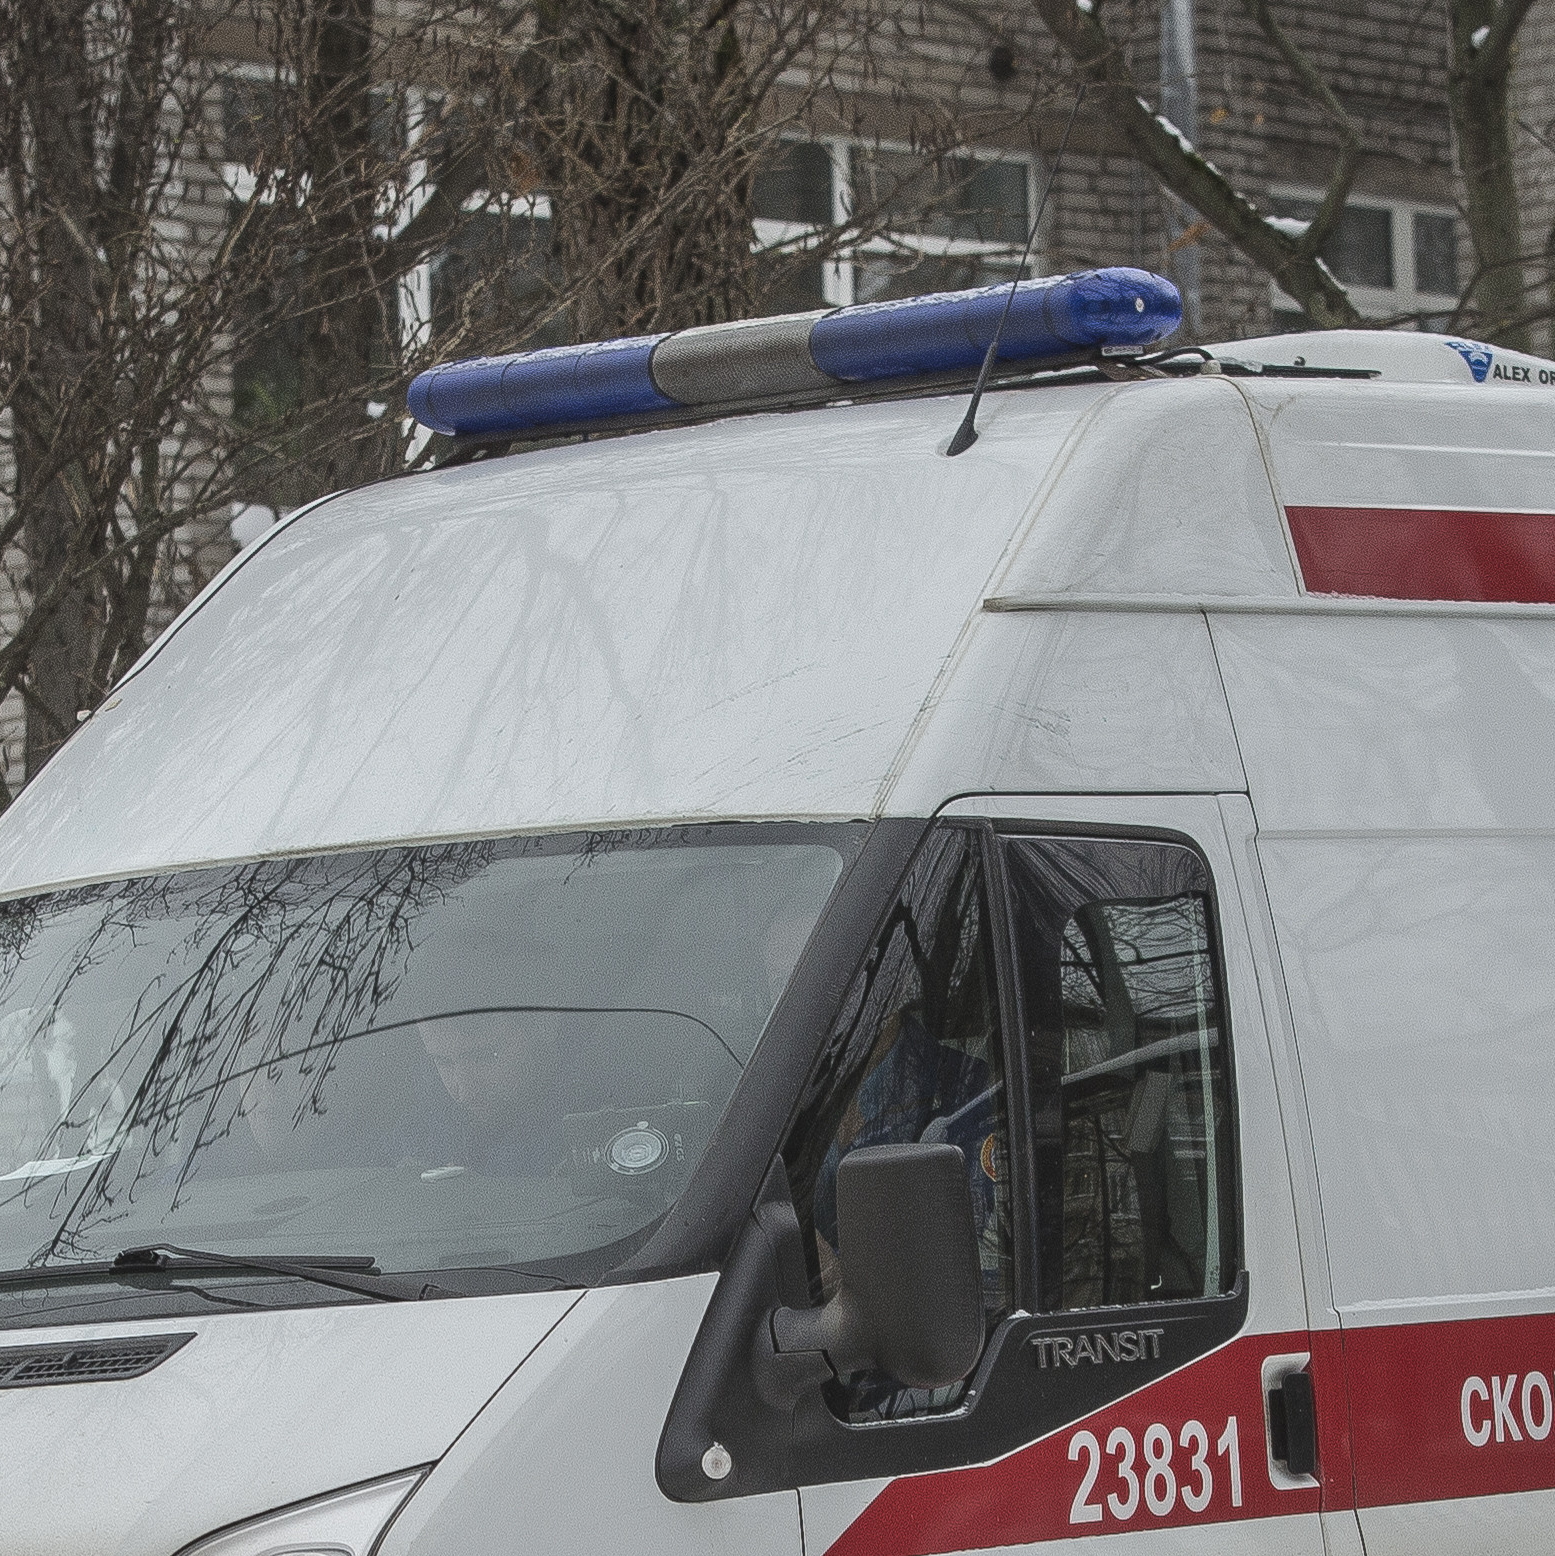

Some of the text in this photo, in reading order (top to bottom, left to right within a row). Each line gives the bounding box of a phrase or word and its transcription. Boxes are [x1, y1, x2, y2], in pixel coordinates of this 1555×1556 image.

[1494, 363, 1531, 383] ALEX
[1032, 1327, 1164, 1370] TRANSIT
[1068, 1415, 1243, 1525] 23831
